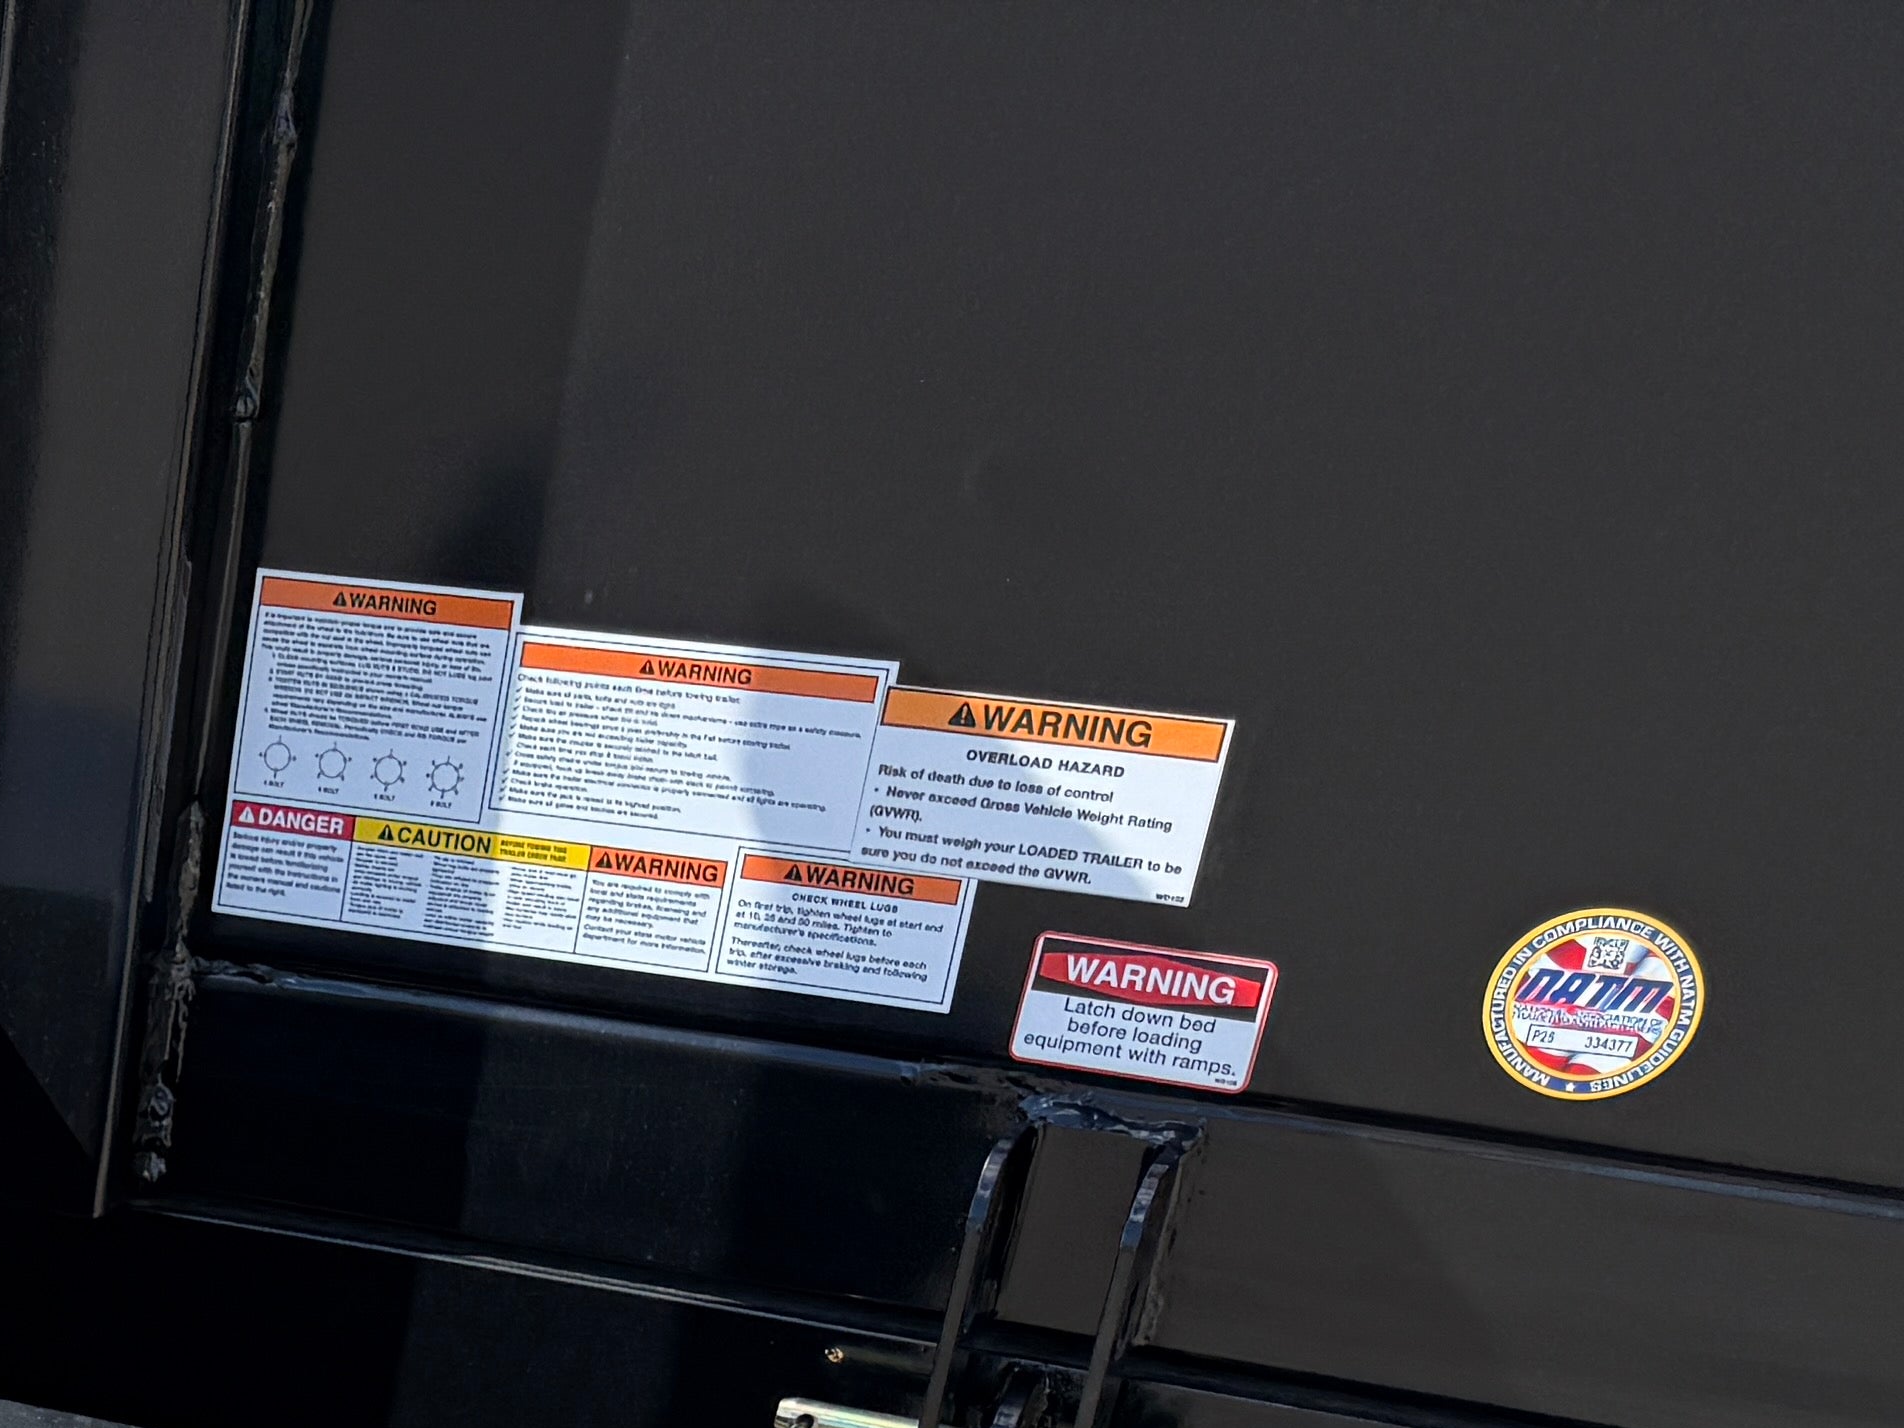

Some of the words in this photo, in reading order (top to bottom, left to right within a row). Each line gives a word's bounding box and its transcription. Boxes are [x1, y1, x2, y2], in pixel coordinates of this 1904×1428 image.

[349, 592, 437, 616] WARNING
[658, 659, 752, 685] WARNING
[983, 703, 1152, 748] WARNING
[966, 749, 1053, 769] OVERLOAD
[1058, 759, 1125, 777] HAZARD
[878, 763, 906, 778] Risk
[910, 768, 925, 780] of
[927, 770, 965, 785] death
[968, 775, 994, 788] due
[997, 778, 1012, 791] to
[1014, 780, 1043, 794] loss
[1046, 784, 1062, 796] of
[1063, 788, 1114, 802] control
[258, 807, 344, 835] DANGER
[886, 785, 925, 801] Never
[928, 793, 977, 807] exceed
[980, 797, 1020, 813] Gross
[1024, 801, 1072, 819] Vehicle
[1076, 808, 1124, 825] Weight
[1127, 815, 1172, 833] Rating
[397, 826, 491, 854] CAUTION
[878, 825, 902, 839] You
[904, 831, 939, 844] must
[942, 837, 982, 850] weigh
[983, 842, 1016, 854] your
[1018, 843, 1078, 861] LOADED
[1082, 851, 1143, 870] TRAILER
[1147, 860, 1161, 872] to
[1164, 861, 1182, 874] be
[614, 852, 718, 882] WARNING
[806, 864, 914, 895] WARNING
[861, 846, 889, 858] sure
[892, 850, 917, 862] you
[920, 852, 937, 864] do
[940, 856, 963, 868] not
[965, 860, 1015, 874] exceed
[1018, 864, 1040, 877] the
[1043, 867, 1091, 884] GVWR.
[791, 892, 828, 905] CHECK
[831, 898, 866, 910] WHEEL
[869, 901, 898, 913] LUGS
[1533, 916, 1655, 949] COMPLIANCE
[1515, 947, 1533, 967] IN
[1655, 933, 1688, 973] WITH
[1067, 954, 1236, 1005] WARNING
[1516, 968, 1673, 1013] NATM
[1063, 996, 1115, 1019] Latch
[1121, 1006, 1173, 1028] down
[1179, 1013, 1217, 1033] bed
[1677, 971, 1695, 1026] NATM
[1067, 1017, 1127, 1040] before
[1132, 1026, 1202, 1054] loading
[1492, 967, 1551, 1086] MANUFACTURED
[1023, 1033, 1122, 1059] equipment
[1128, 1047, 1166, 1065] with
[1171, 1055, 1235, 1076] ramps.
